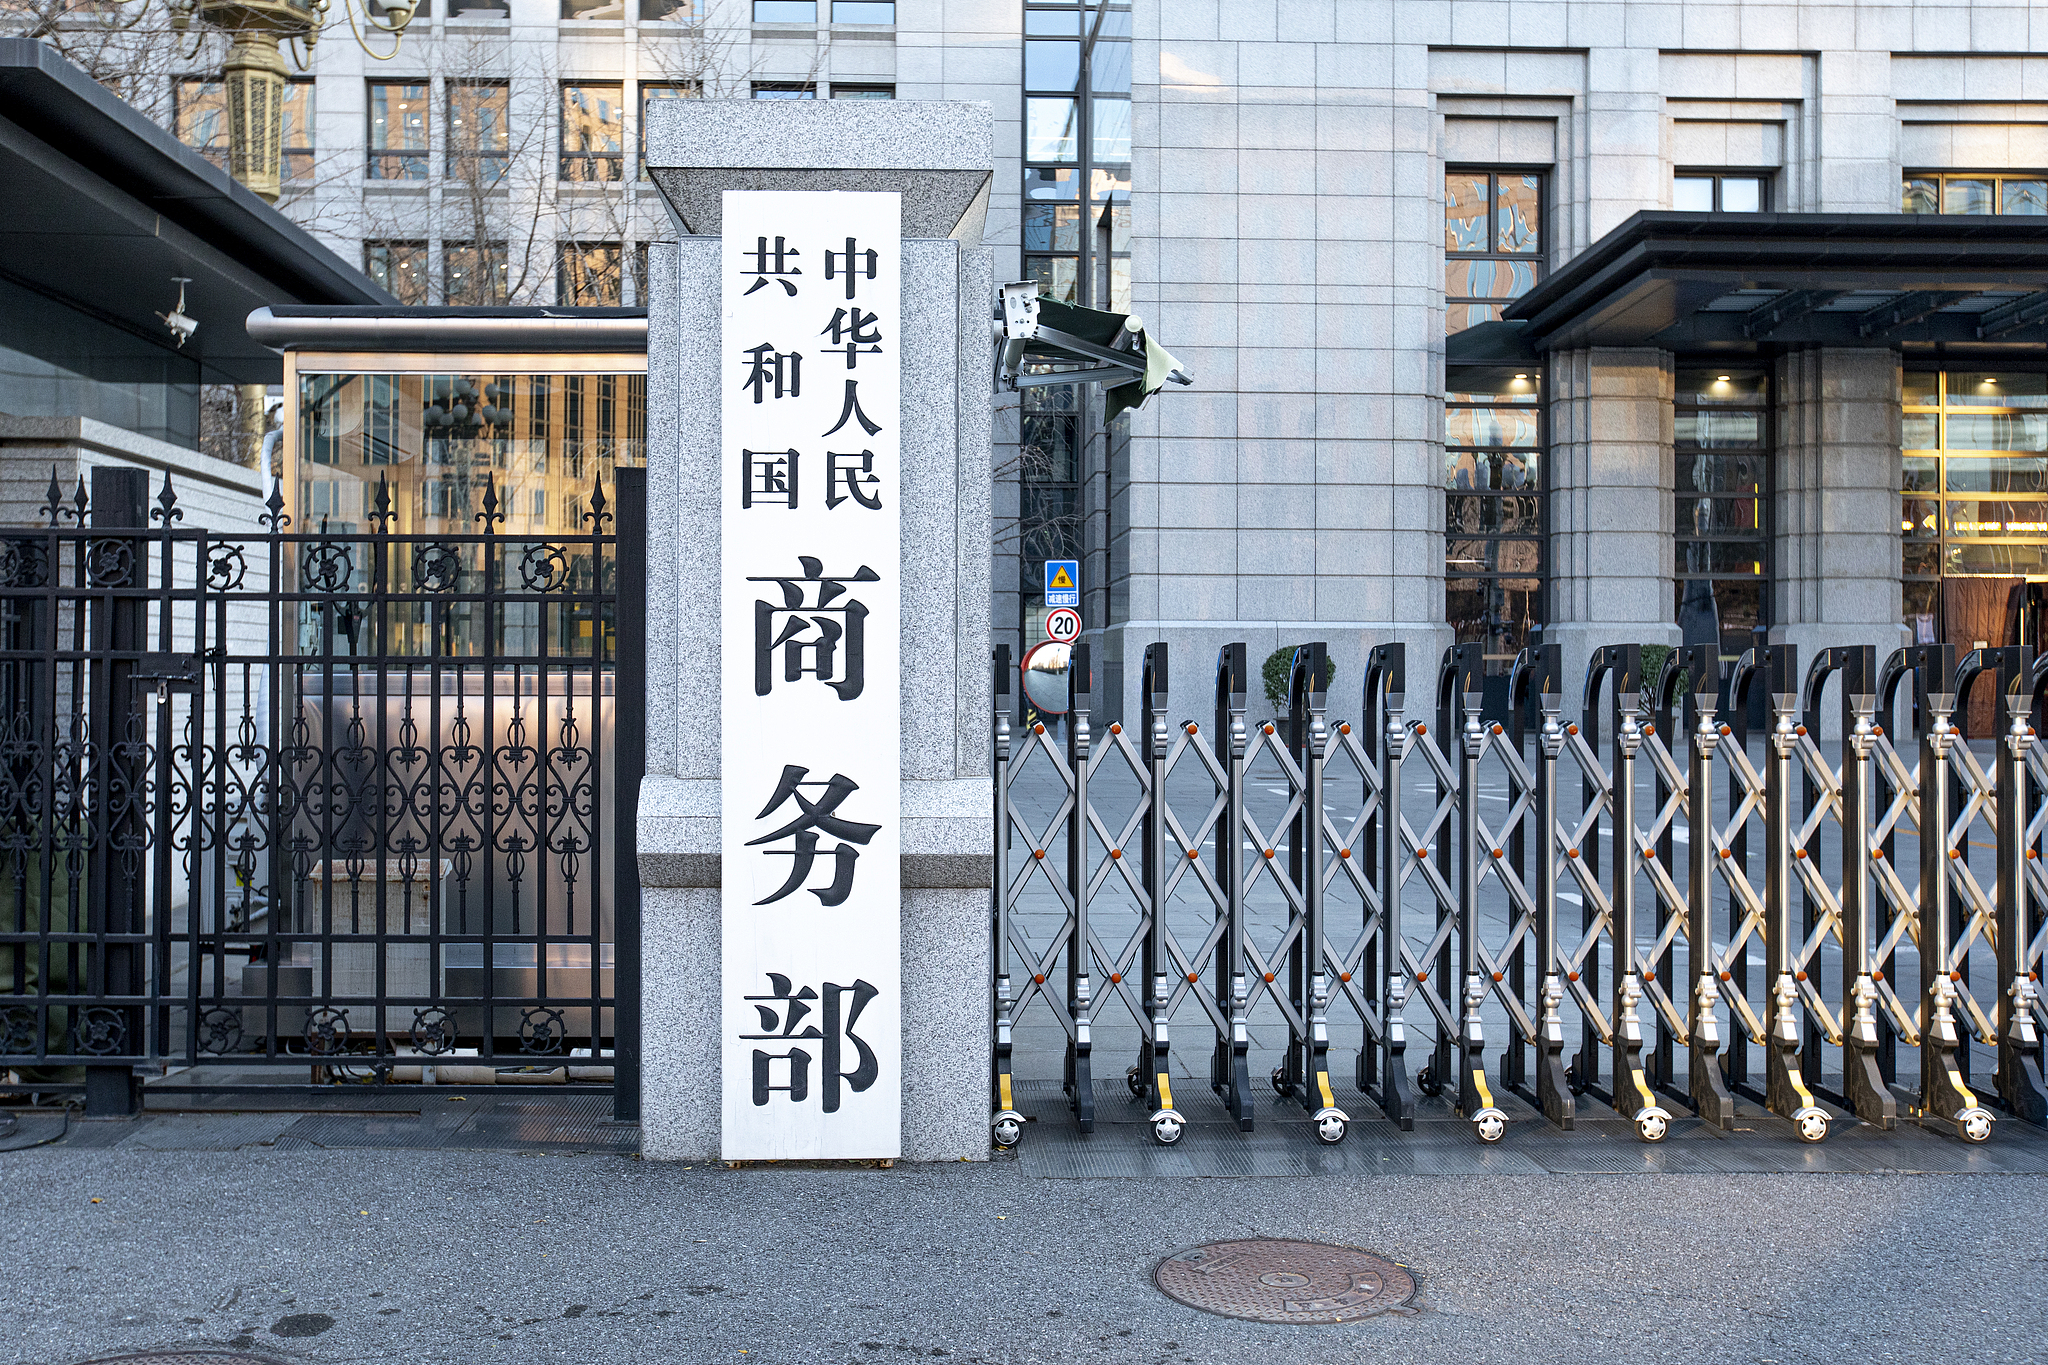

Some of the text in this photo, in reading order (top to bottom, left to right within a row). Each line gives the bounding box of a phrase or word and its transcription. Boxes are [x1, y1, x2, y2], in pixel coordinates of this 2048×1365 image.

[740, 235, 803, 510] 共和国
[820, 236, 883, 511] 中华人民
[1054, 617, 1074, 635] 20
[738, 555, 883, 1114] 商务部
